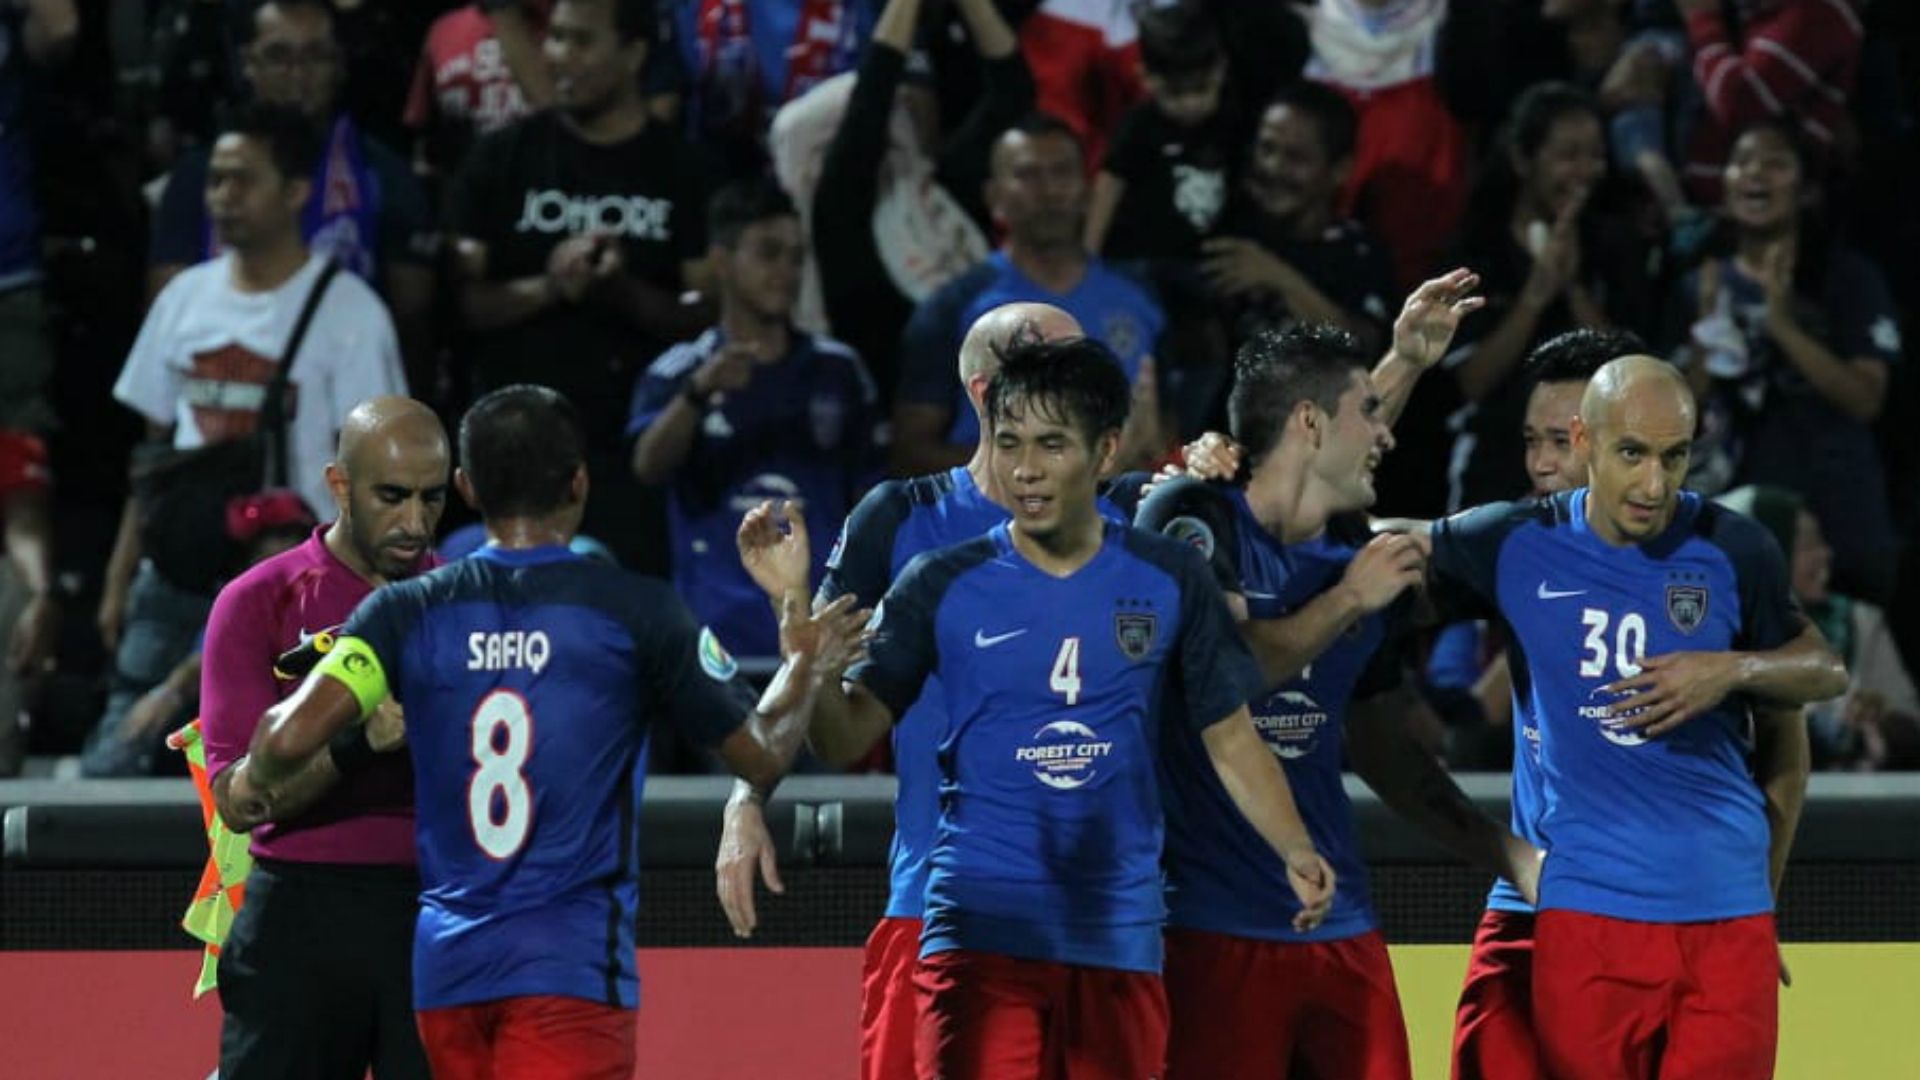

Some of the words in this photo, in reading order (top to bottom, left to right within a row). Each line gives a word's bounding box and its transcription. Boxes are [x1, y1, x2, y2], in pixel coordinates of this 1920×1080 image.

[516, 189, 672, 240] JOHORE
[467, 631, 549, 673] SAFIQ
[1050, 637, 1081, 705] 4
[1579, 608, 1646, 678] 30
[467, 687, 534, 863] 8
[1016, 744, 1075, 761] FOREST
[1077, 741, 1112, 757] CITY
